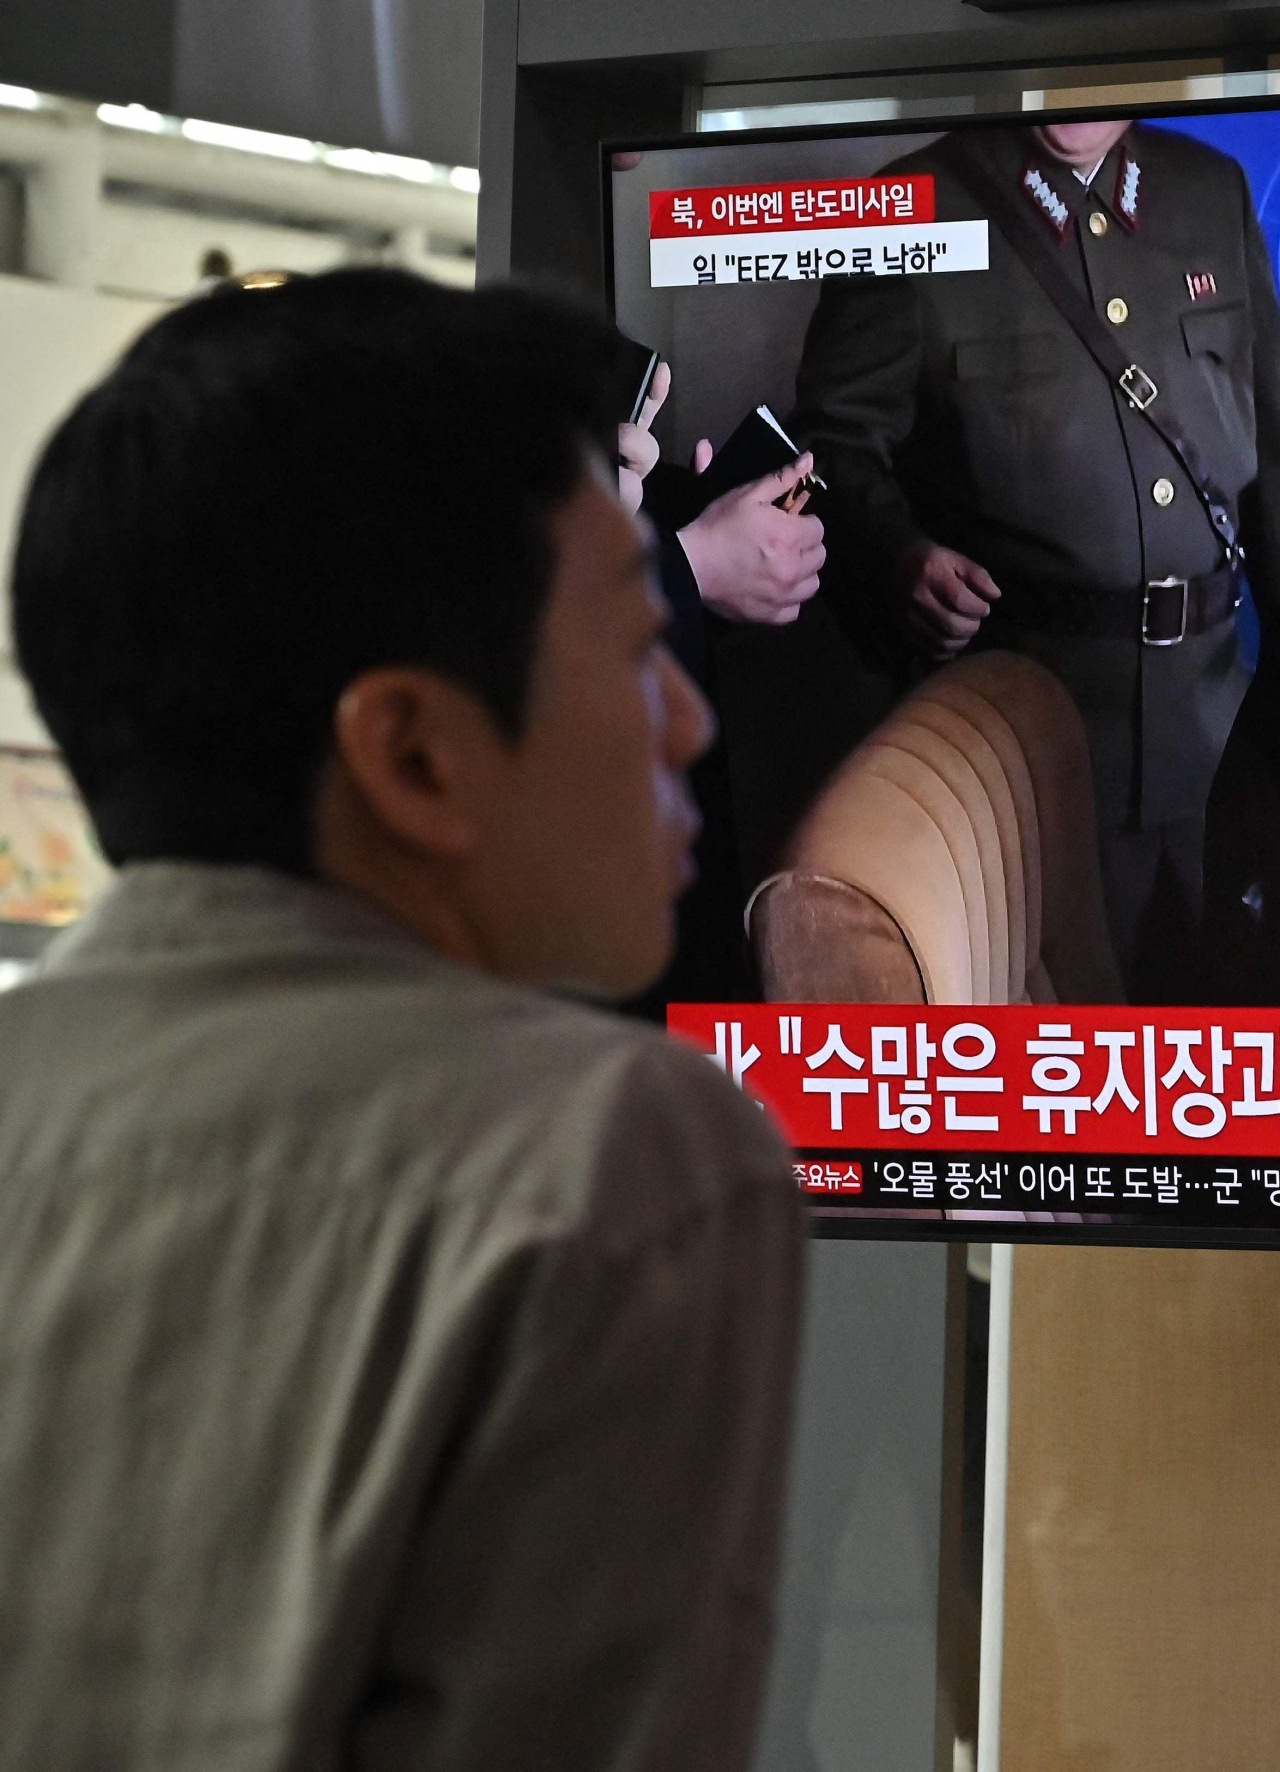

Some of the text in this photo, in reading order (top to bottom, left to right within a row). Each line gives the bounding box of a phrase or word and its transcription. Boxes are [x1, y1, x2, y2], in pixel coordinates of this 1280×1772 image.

[671, 183, 914, 229] 북, 이번엔 탄도미사일
[725, 253, 789, 282] "EEZ
[796, 247, 876, 279] 밖으로
[884, 241, 947, 274] 낙하"
[778, 1015, 1004, 1134] "수많은
[792, 1164, 861, 1190] 주요뉴스
[873, 1161, 938, 1198] '오물
[944, 1162, 1009, 1200] 풍선'
[1019, 1163, 1075, 1201] 이어
[1084, 1167, 1115, 1197] 또
